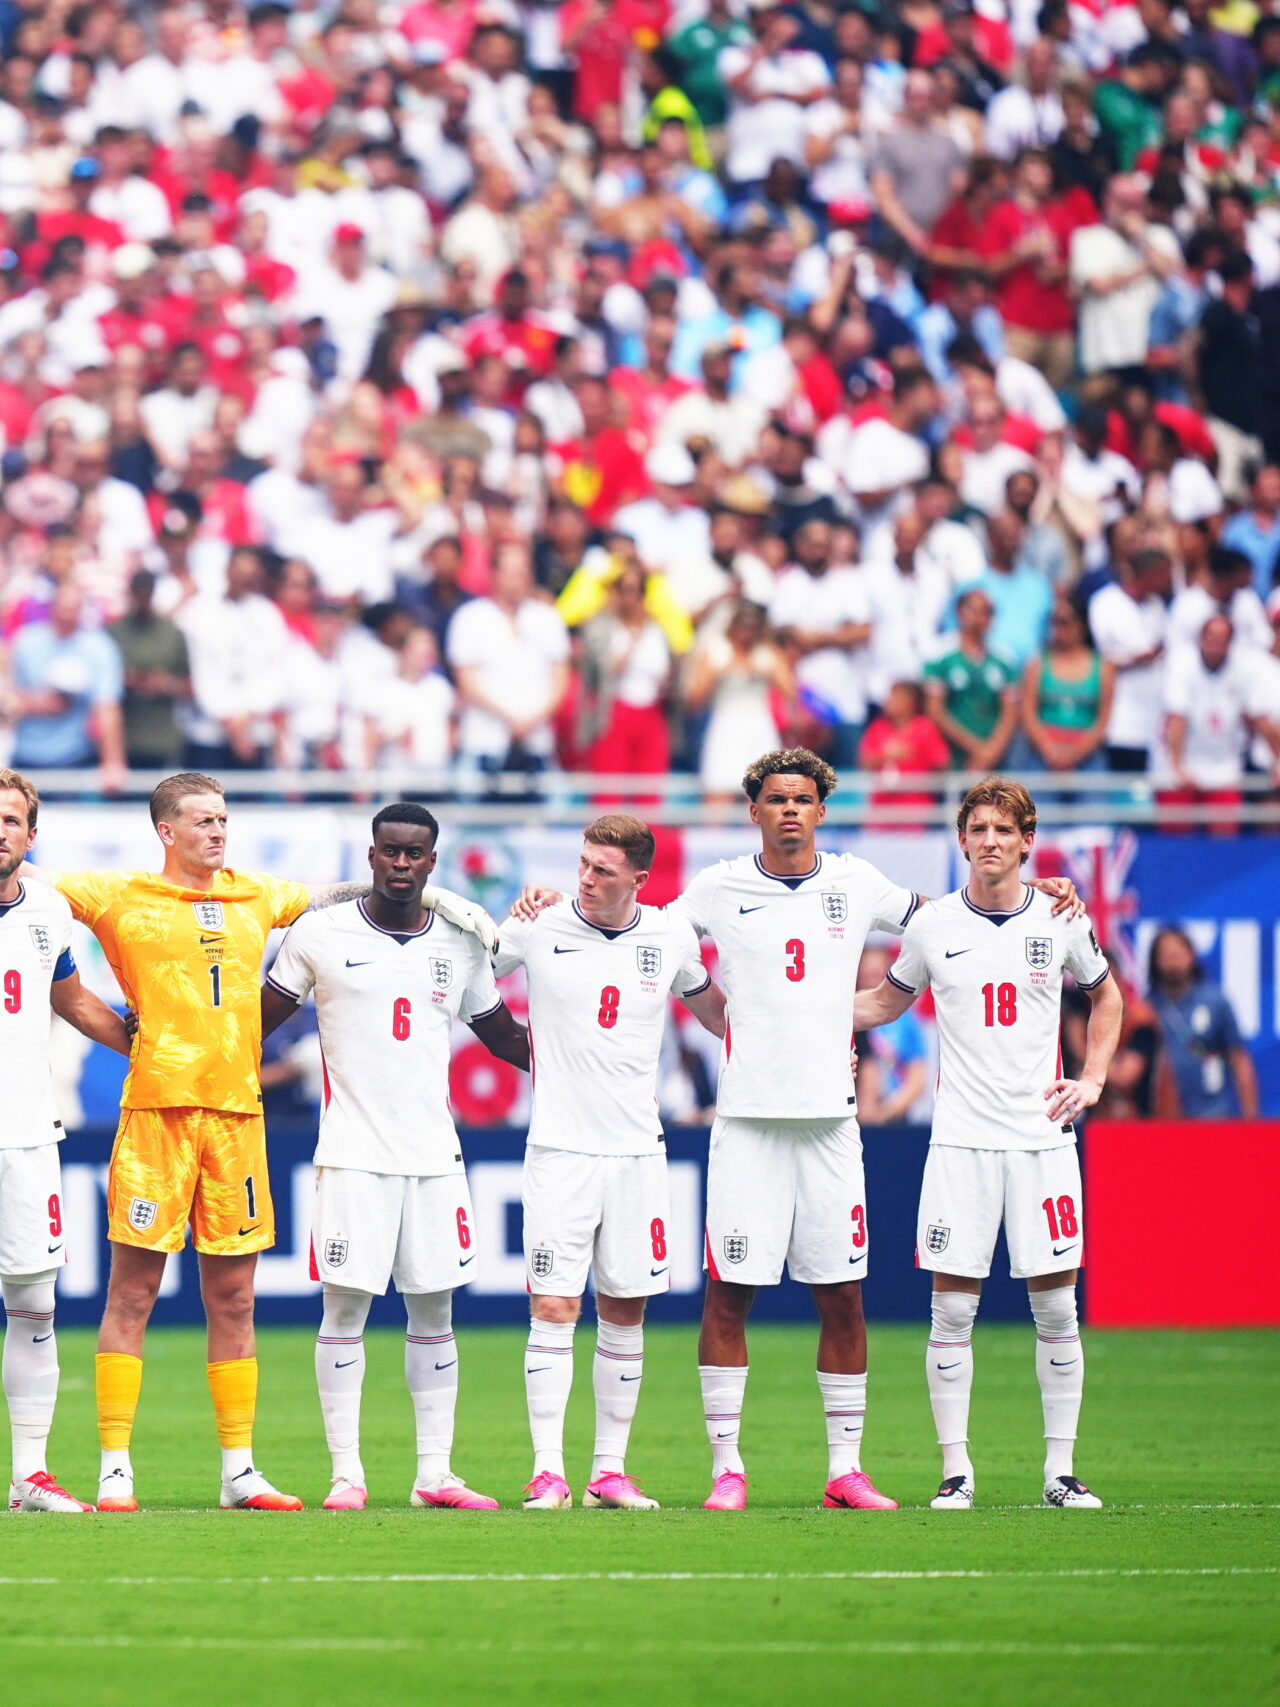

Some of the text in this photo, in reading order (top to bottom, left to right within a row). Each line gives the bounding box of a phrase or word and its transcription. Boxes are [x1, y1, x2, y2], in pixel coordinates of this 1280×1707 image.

[785, 938, 805, 982] 3
[3, 969, 21, 1014] 9
[208, 963, 221, 1008] 1
[597, 985, 620, 1029] 8
[981, 982, 1017, 1027] 18
[392, 997, 411, 1041] 6
[47, 1193, 62, 1237] 9
[244, 1175, 257, 1219] 1
[1042, 1195, 1079, 1241] 18
[456, 1207, 471, 1250] 6
[650, 1217, 667, 1261] 8
[851, 1204, 866, 1248] 3
